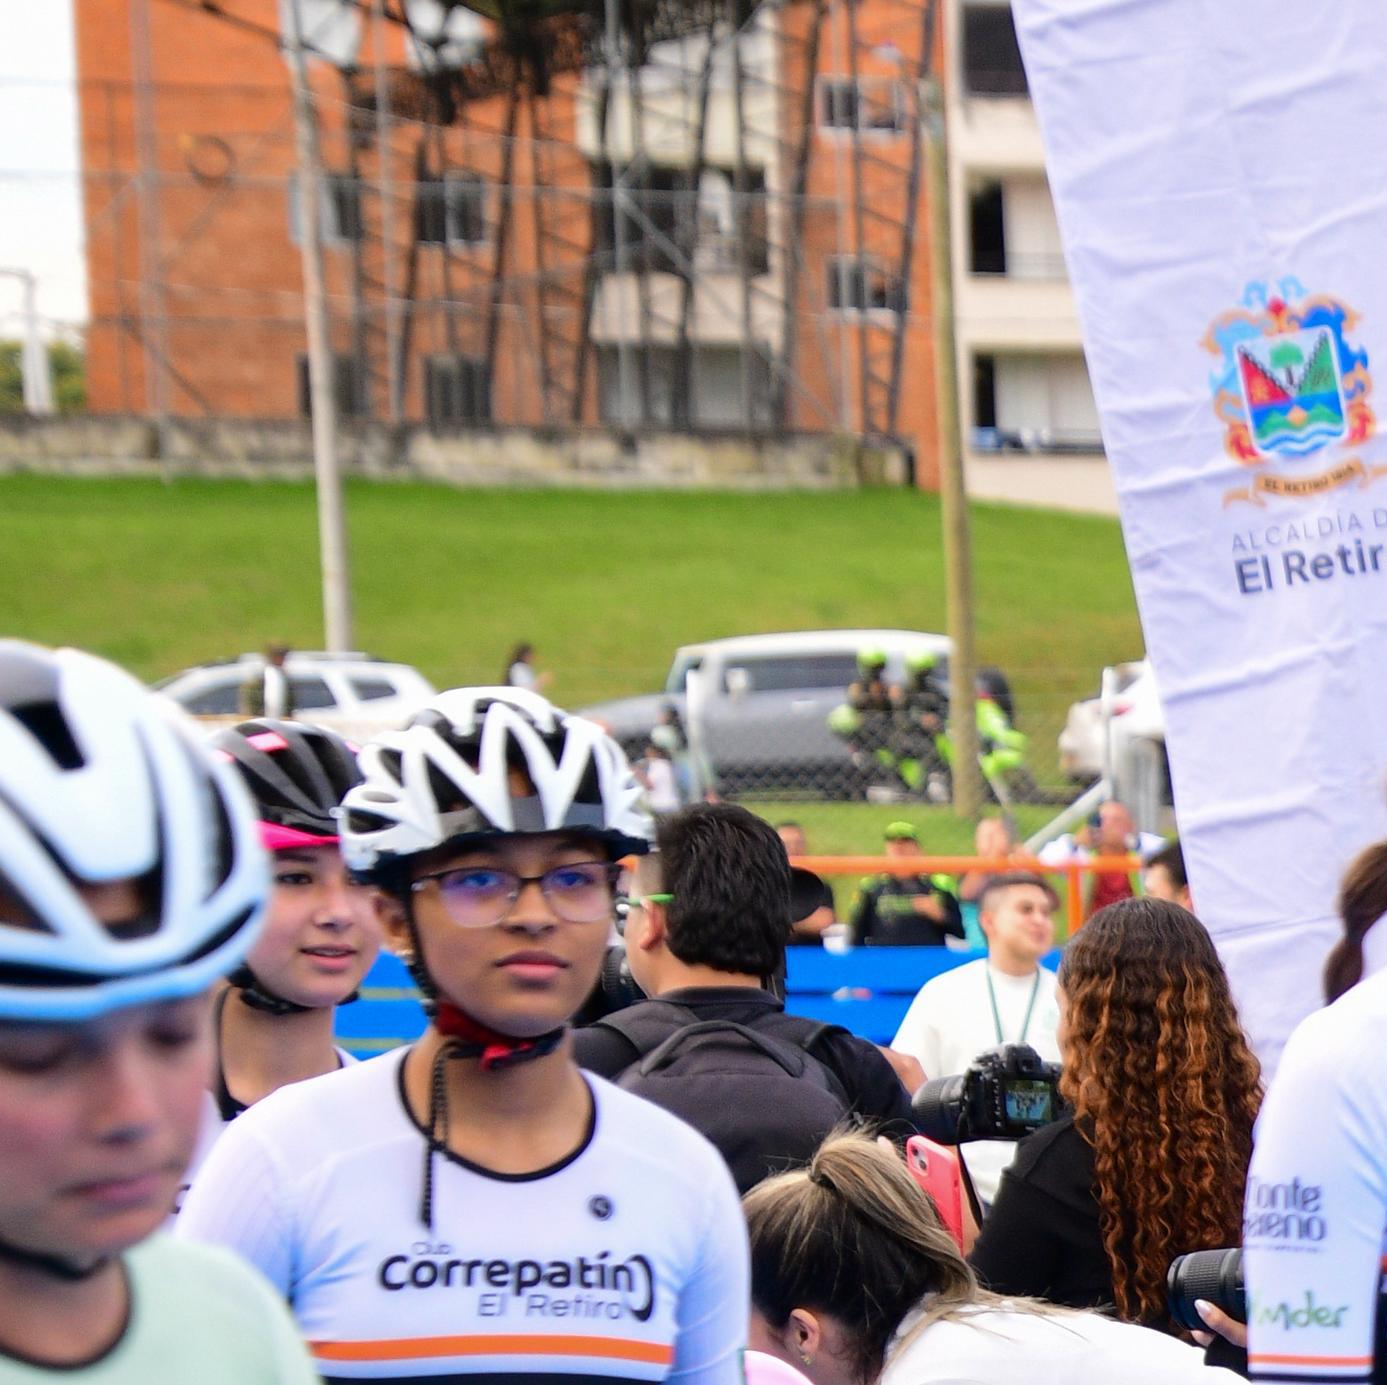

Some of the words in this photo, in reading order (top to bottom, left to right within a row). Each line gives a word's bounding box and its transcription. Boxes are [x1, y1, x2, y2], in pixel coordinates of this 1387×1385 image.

[1232, 508, 1363, 552] ALCALDÍA
[1235, 555, 1274, 594] El
[380, 1251, 634, 1297] Correpatín
[478, 1293, 507, 1318] El
[526, 1294, 624, 1320] Retiro
